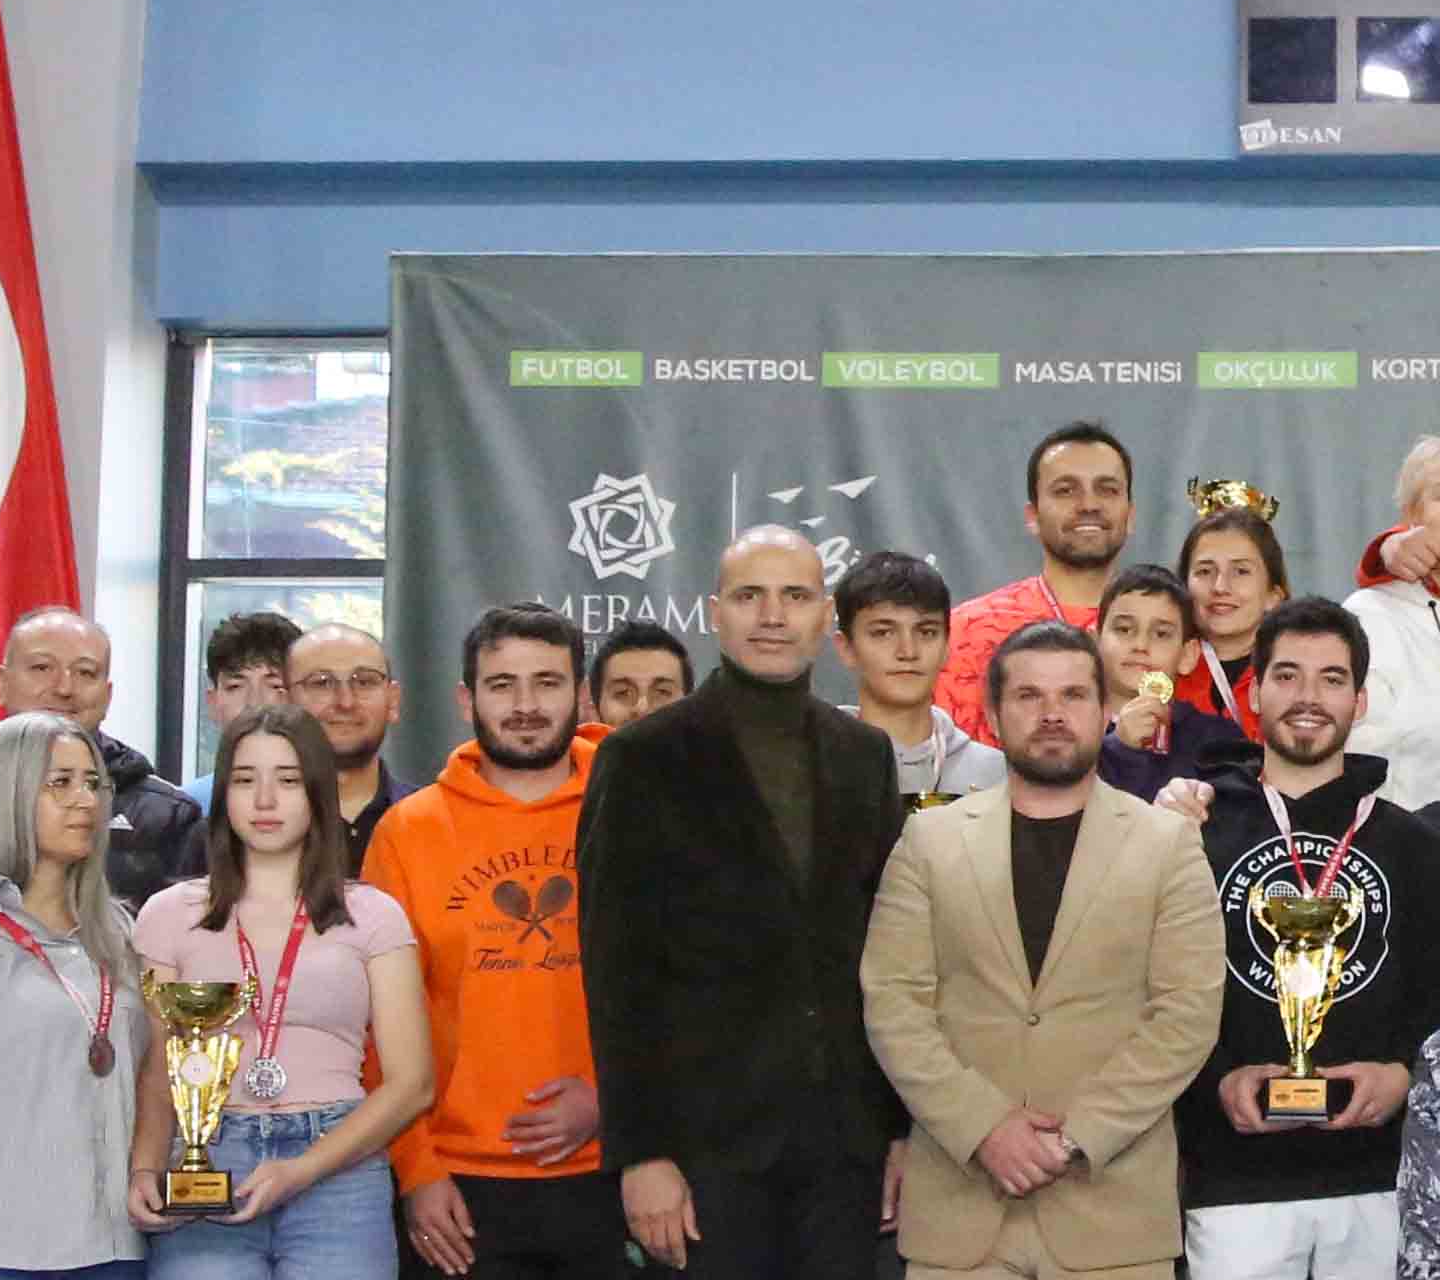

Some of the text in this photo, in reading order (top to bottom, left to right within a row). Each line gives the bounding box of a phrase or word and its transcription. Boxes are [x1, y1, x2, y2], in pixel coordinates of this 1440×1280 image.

[520, 357, 630, 381] FUTBOL
[653, 358, 815, 382] BASKETBOL
[837, 358, 985, 382] VOLEYBOL
[1014, 360, 1094, 384] MASA
[1213, 360, 1338, 388] OKÇULUK
[1226, 872, 1251, 913] THE
